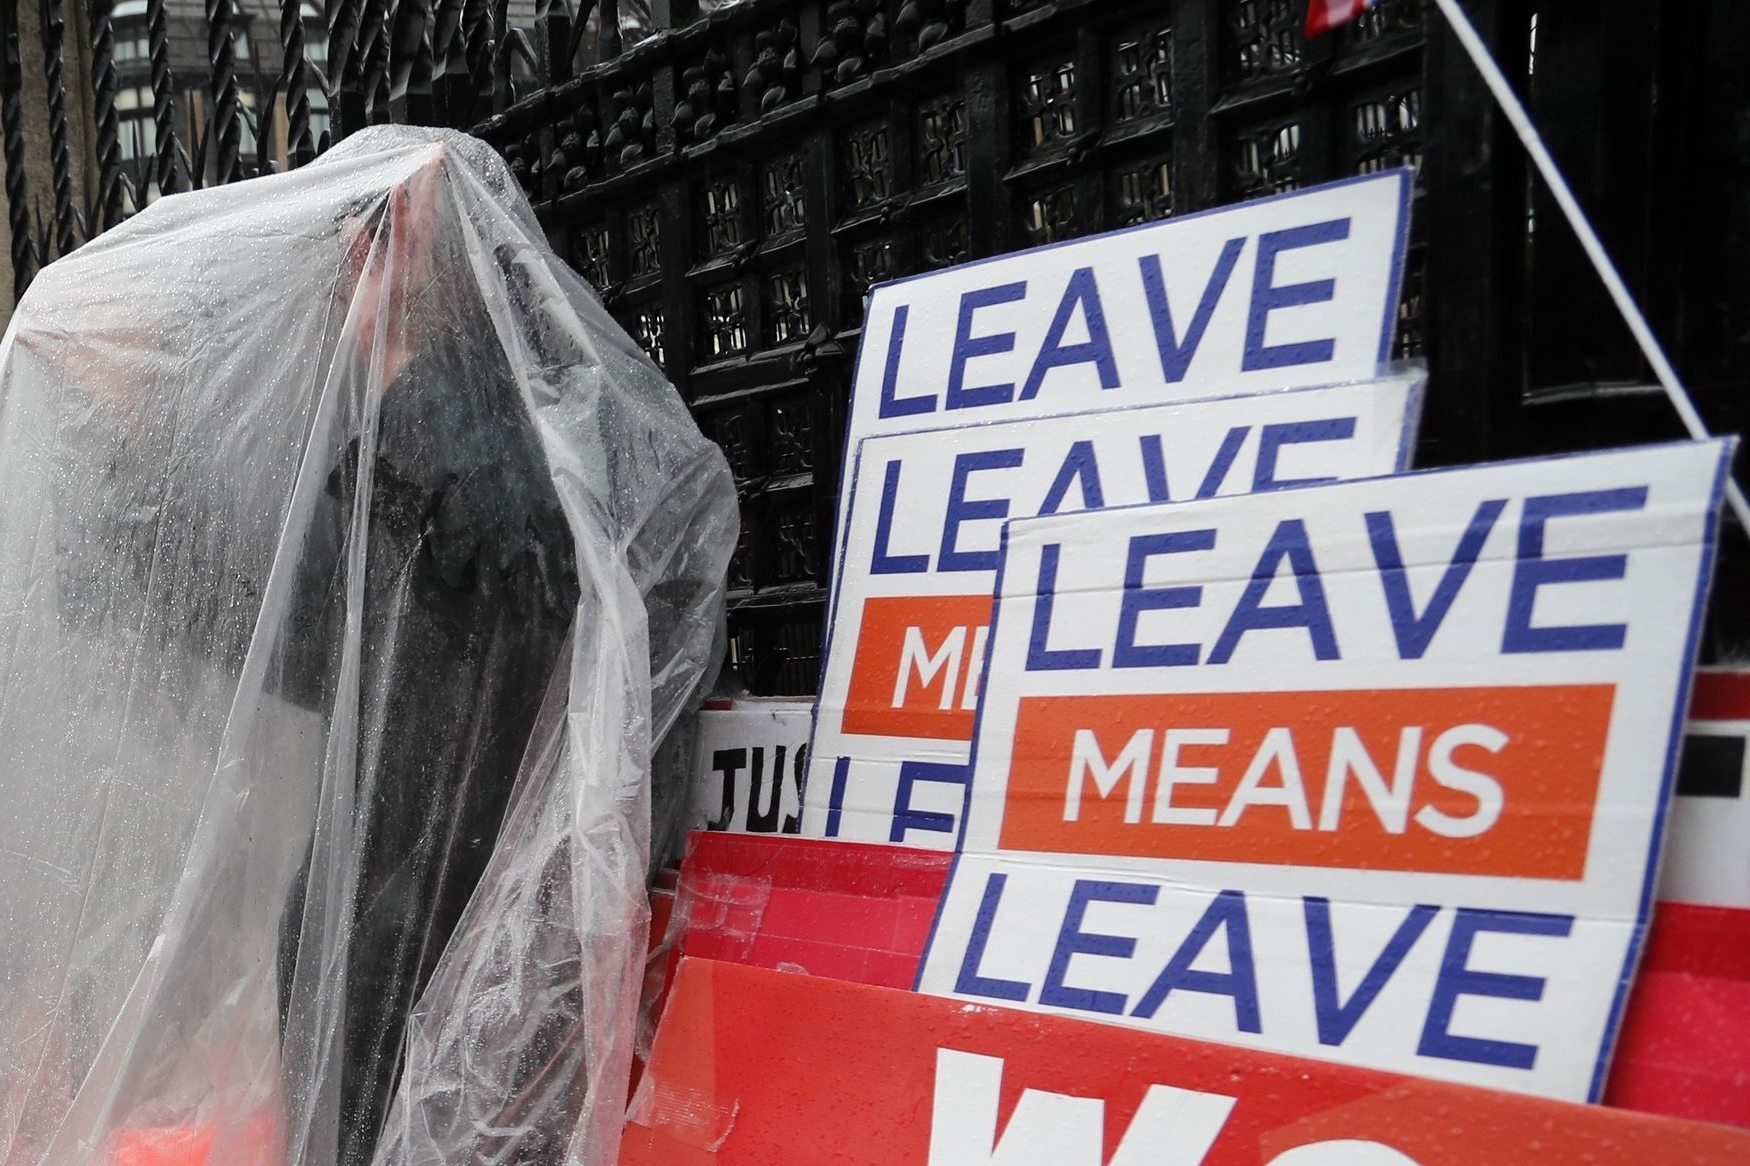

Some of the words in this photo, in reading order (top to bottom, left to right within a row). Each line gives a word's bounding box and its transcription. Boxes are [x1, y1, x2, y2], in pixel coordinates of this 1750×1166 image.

[878, 216, 1351, 420] LEAVE
[1024, 486, 1648, 672] LEAVE
[1063, 723, 1510, 839] MEANS
[954, 872, 1576, 1071] LEAVE
